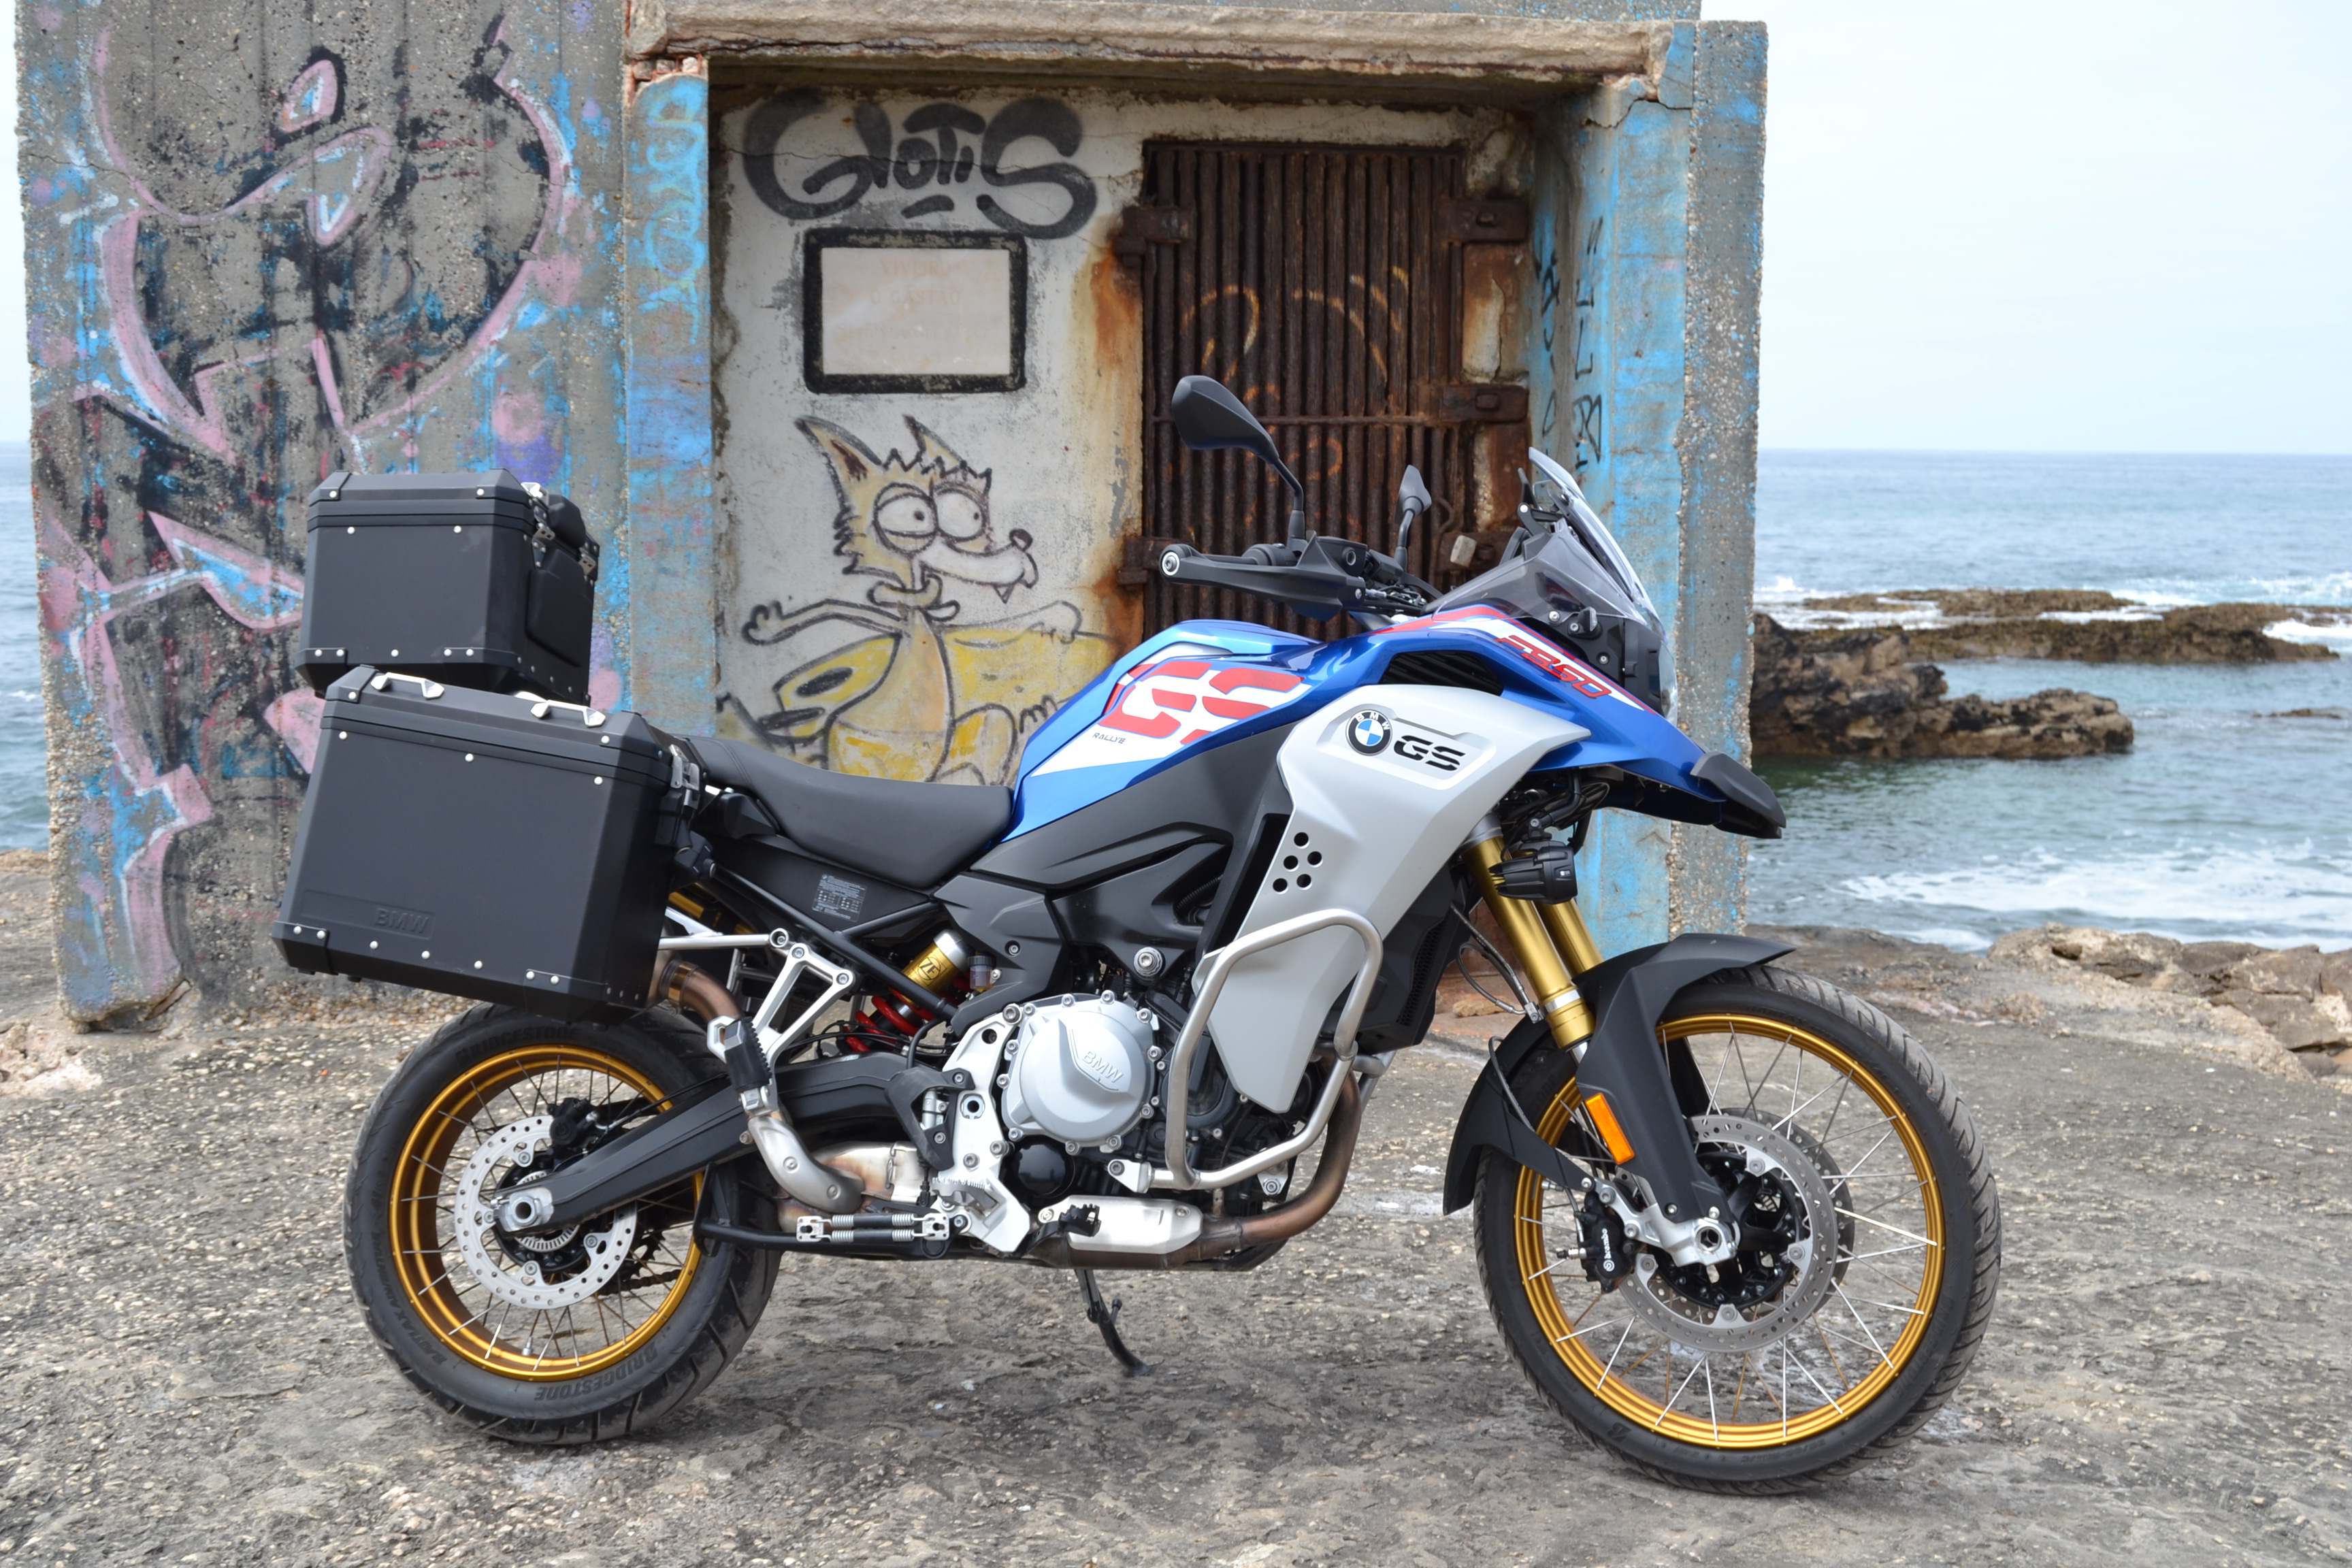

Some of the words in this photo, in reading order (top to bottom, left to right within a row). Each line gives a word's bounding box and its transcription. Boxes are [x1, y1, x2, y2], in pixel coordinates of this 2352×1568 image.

[1092, 732, 1126, 745] RALLYE
[1394, 735, 1466, 771] GS
[376, 907, 430, 934] BMW
[918, 956, 941, 981] ZF
[454, 1026, 579, 1066] BRIDGESTONE
[1081, 1050, 1124, 1083] BMW
[1601, 1228, 1612, 1260] brembo
[534, 1341, 658, 1401] BRIDGESTONE
